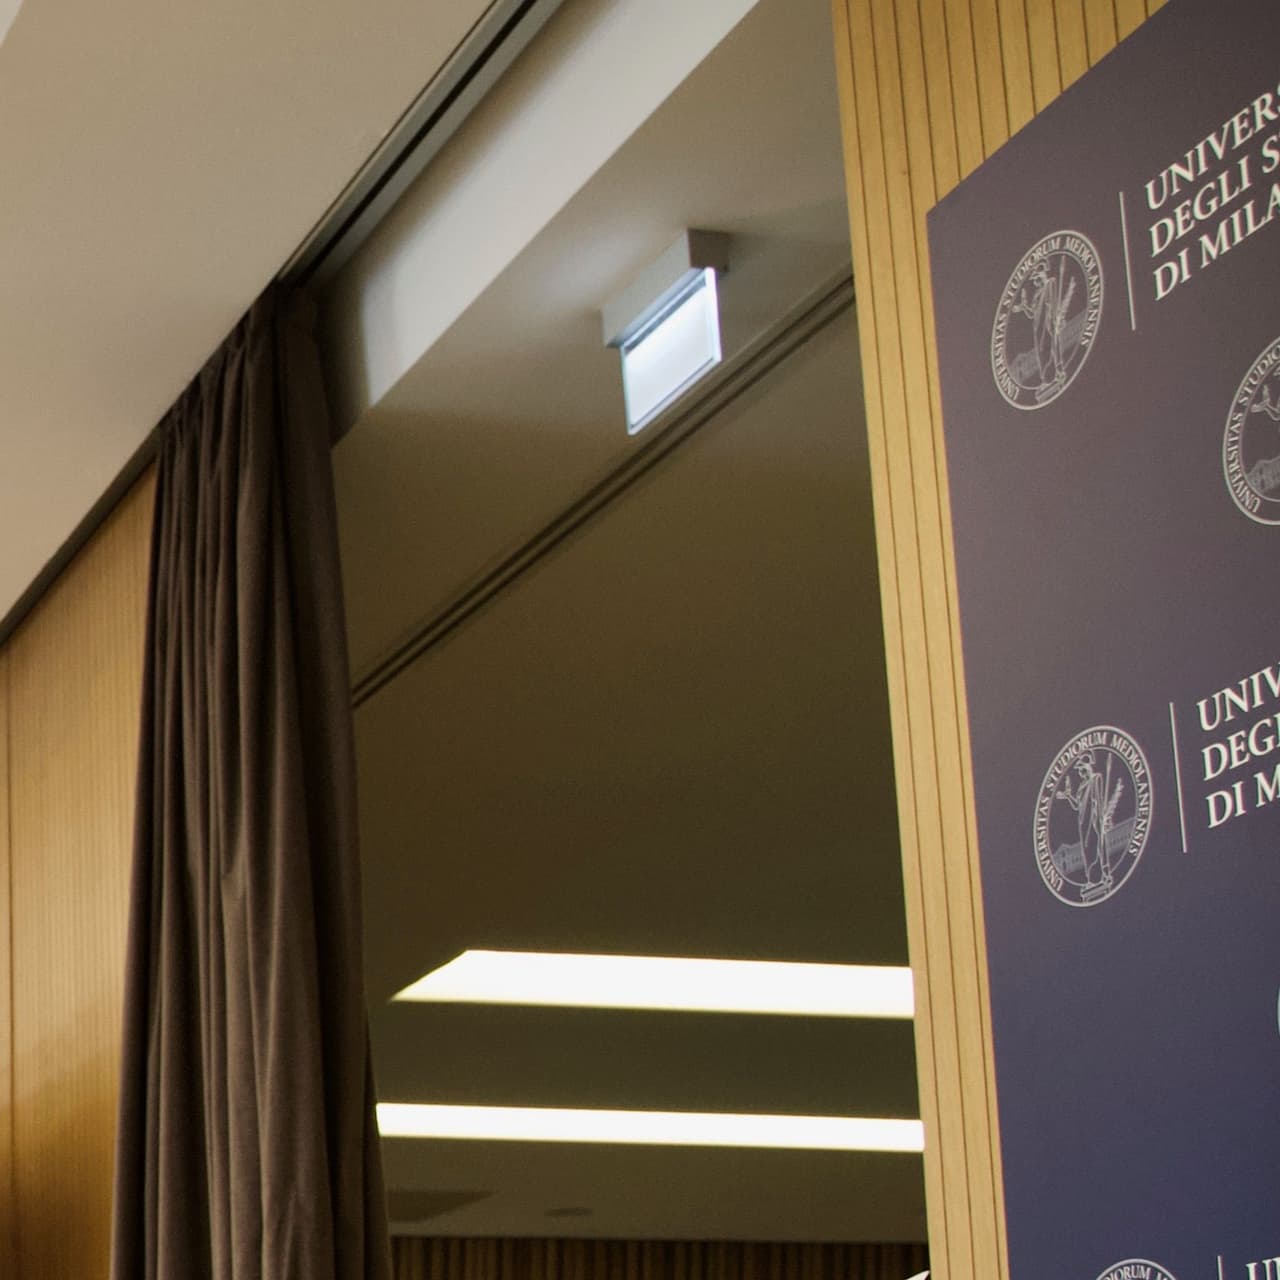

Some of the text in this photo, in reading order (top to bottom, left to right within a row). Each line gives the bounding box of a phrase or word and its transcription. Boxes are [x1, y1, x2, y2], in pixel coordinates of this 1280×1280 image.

[1145, 83, 1280, 210] UNIVER
[1149, 155, 1253, 258] DEGLI
[1153, 247, 1192, 301] DI
[1046, 732, 1107, 792] STUDIORUM
[1205, 780, 1247, 829] DI
